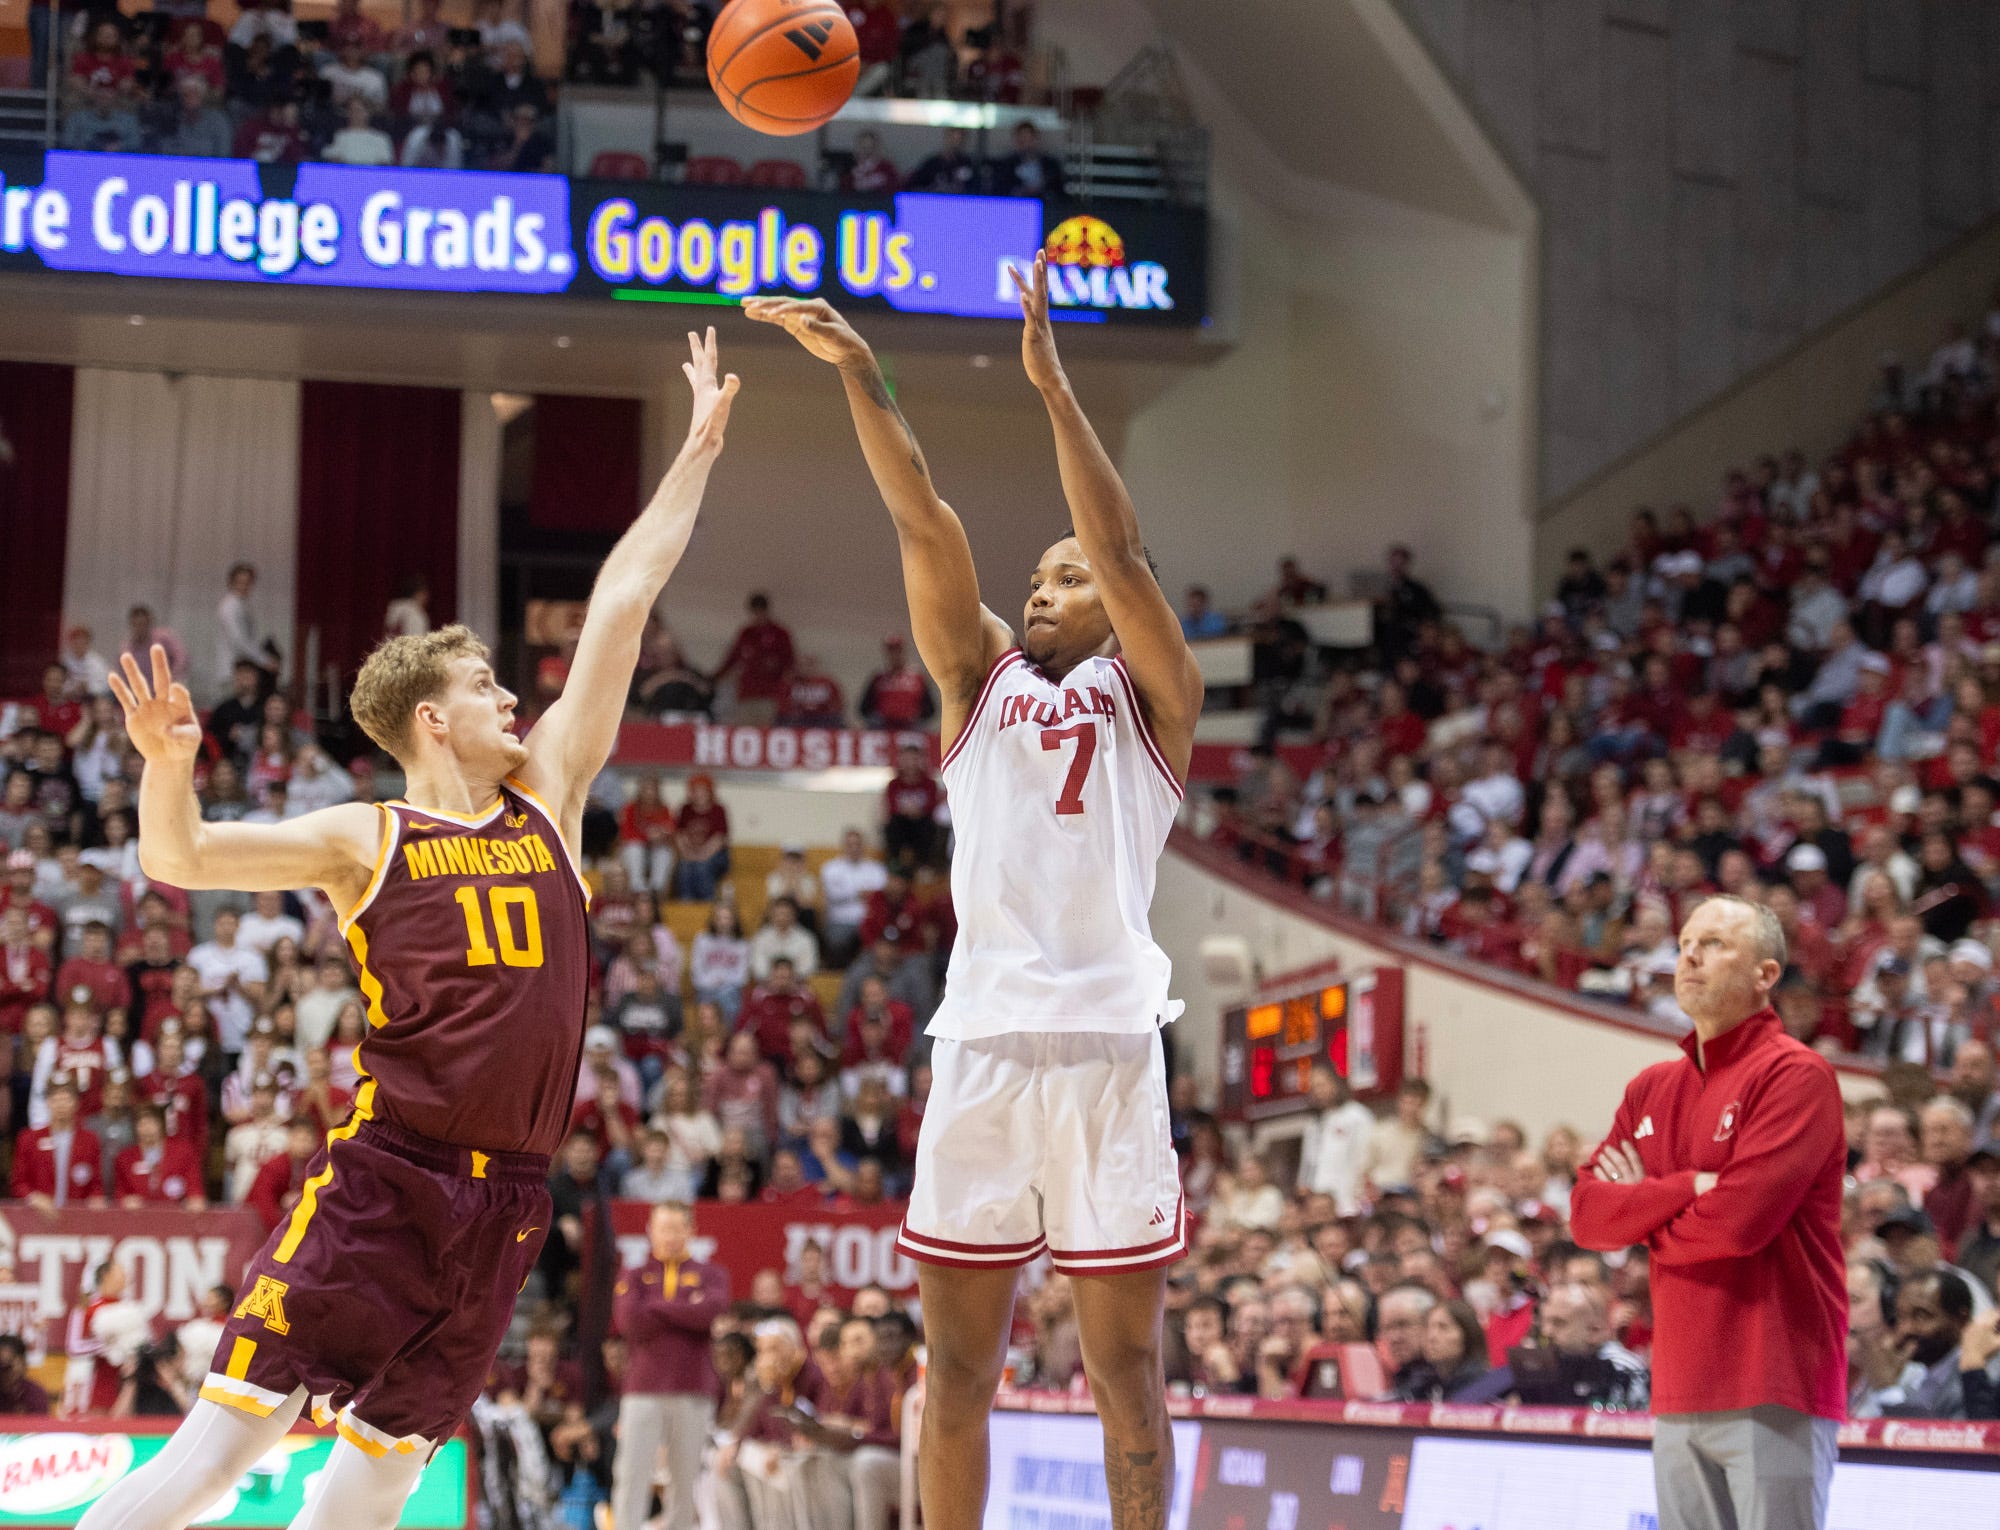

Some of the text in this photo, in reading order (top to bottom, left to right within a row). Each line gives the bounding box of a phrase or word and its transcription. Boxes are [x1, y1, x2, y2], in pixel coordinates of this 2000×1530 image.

[91, 175, 341, 275] College
[360, 189, 572, 274] Grads.
[594, 199, 936, 293] Google Us.
[1040, 722, 1097, 815] 7
[402, 833, 556, 881] MINNESOTA
[454, 886, 544, 967] 10
